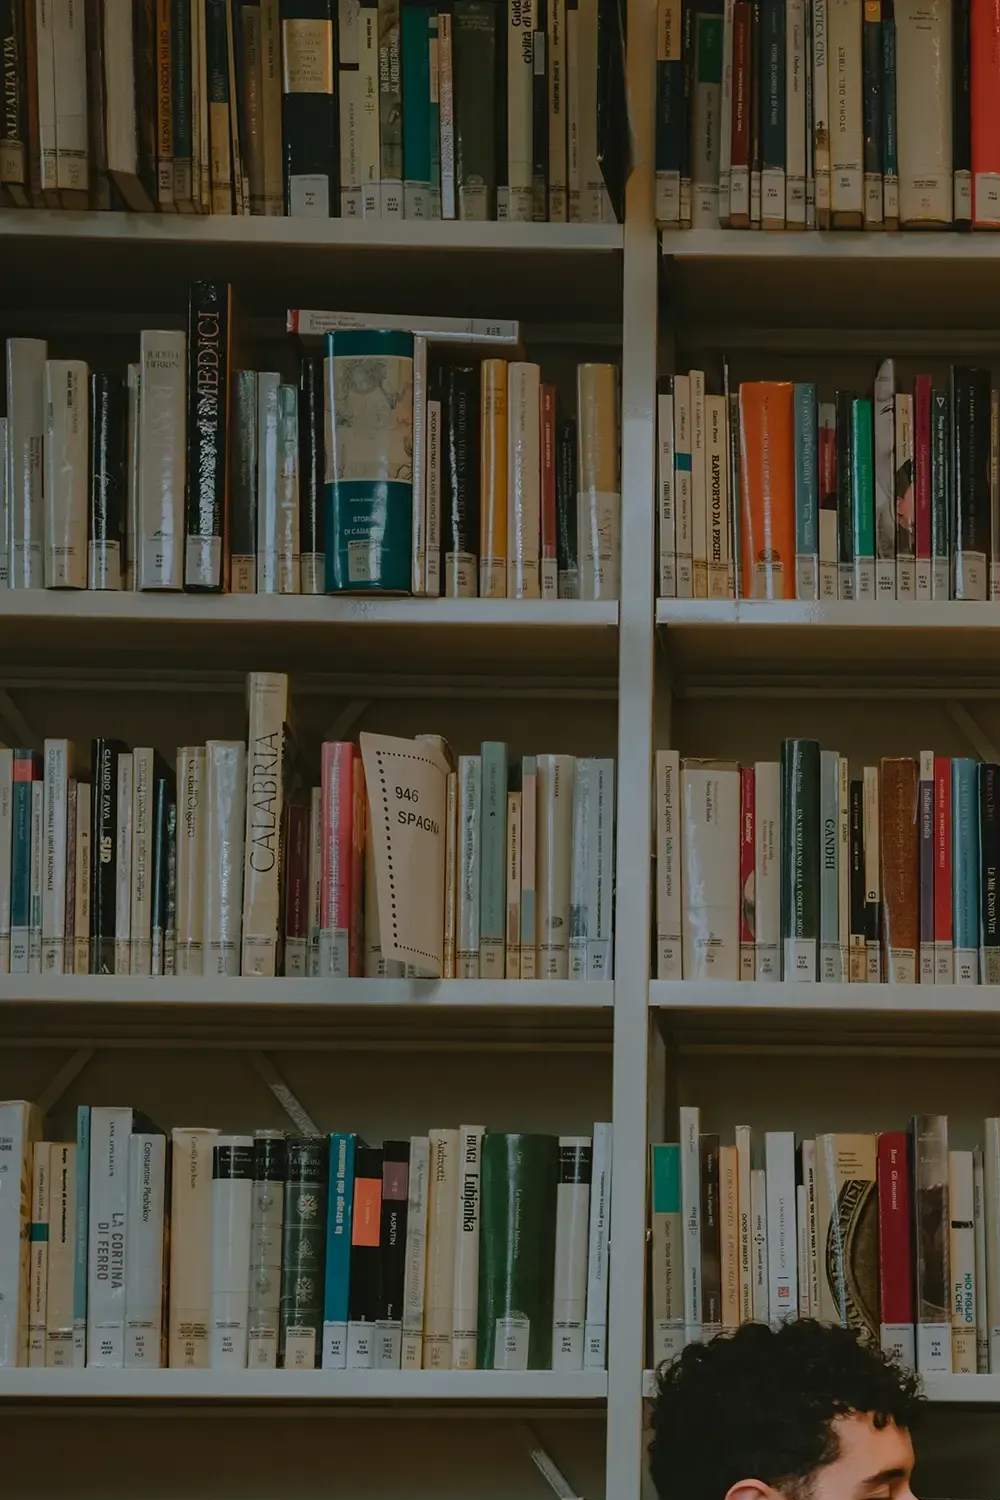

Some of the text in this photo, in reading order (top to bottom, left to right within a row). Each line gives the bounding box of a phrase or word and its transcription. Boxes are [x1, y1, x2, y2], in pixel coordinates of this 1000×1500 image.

[711, 455, 721, 507] RAPPORTO
[712, 509, 721, 526] DA
[103, 749, 111, 819] CLAUDIO FAVA
[185, 760, 198, 838] G. dall'Ongaro
[249, 732, 278, 872] CALABRIA
[394, 786, 420, 803] 946
[663, 765, 672, 804] Dominique
[664, 806, 673, 833] Lapierre
[797, 809, 802, 820] UN
[100, 835, 112, 863] SUD
[665, 837, 673, 853] India
[824, 819, 835, 870] GANDHI
[435, 1139, 448, 1182] Andreotti
[466, 1135, 477, 1163] BIAGI
[141, 1142, 152, 1222] Constantine Pleshakov
[461, 1173, 478, 1232] Lubjanka
[96, 1222, 109, 1280] DI FERRO
[111, 1212, 123, 1289] LA CORTINA
[389, 1212, 397, 1245] RASPUTIN
[964, 1273, 973, 1323] MIO FIGLIO
